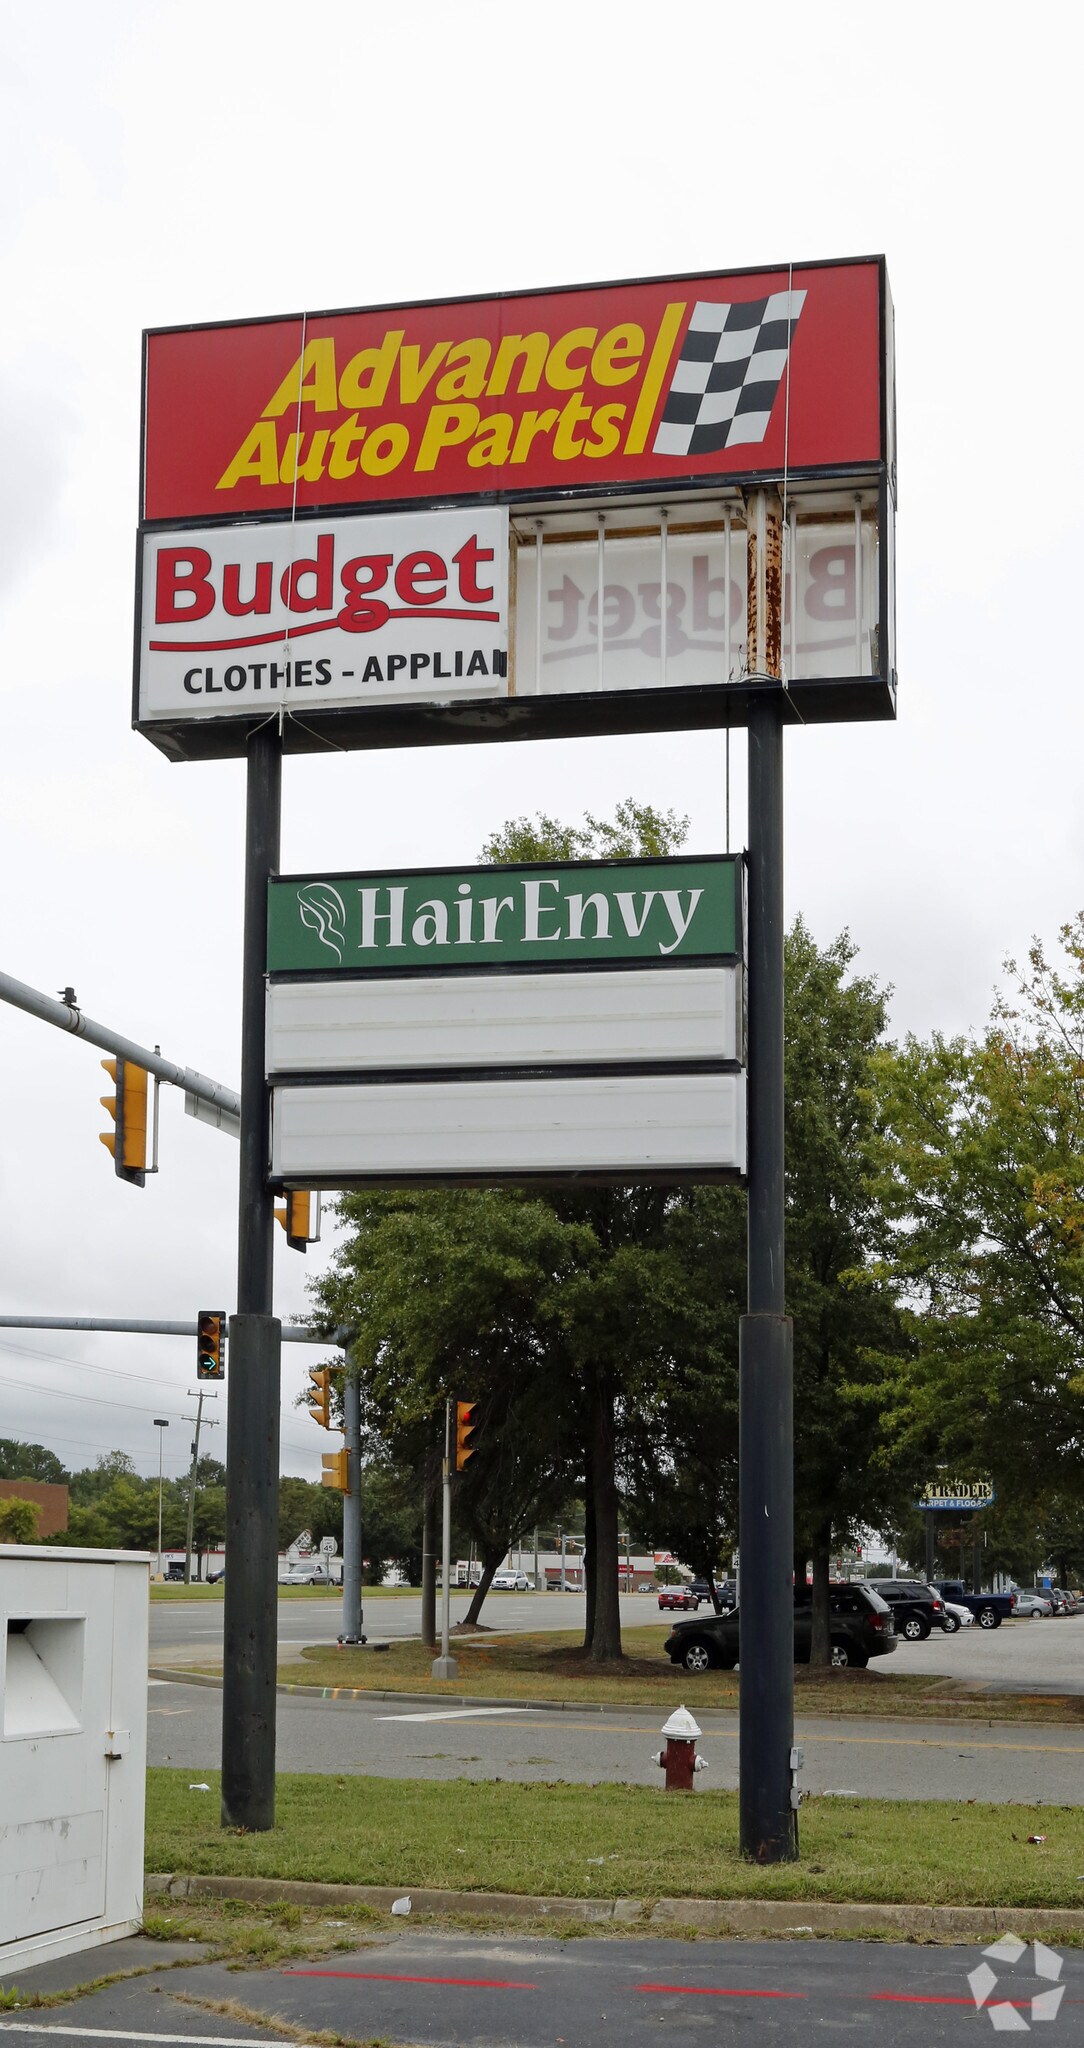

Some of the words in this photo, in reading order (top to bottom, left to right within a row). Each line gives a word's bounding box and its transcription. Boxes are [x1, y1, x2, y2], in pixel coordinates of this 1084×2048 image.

[261, 323, 645, 418] Advance
[215, 413, 410, 490] Auto
[414, 392, 626, 472] Parts
[155, 534, 495, 633] Budget
[183, 659, 332, 695] CLOTHES
[931, 1484, 989, 1497] TRADER
